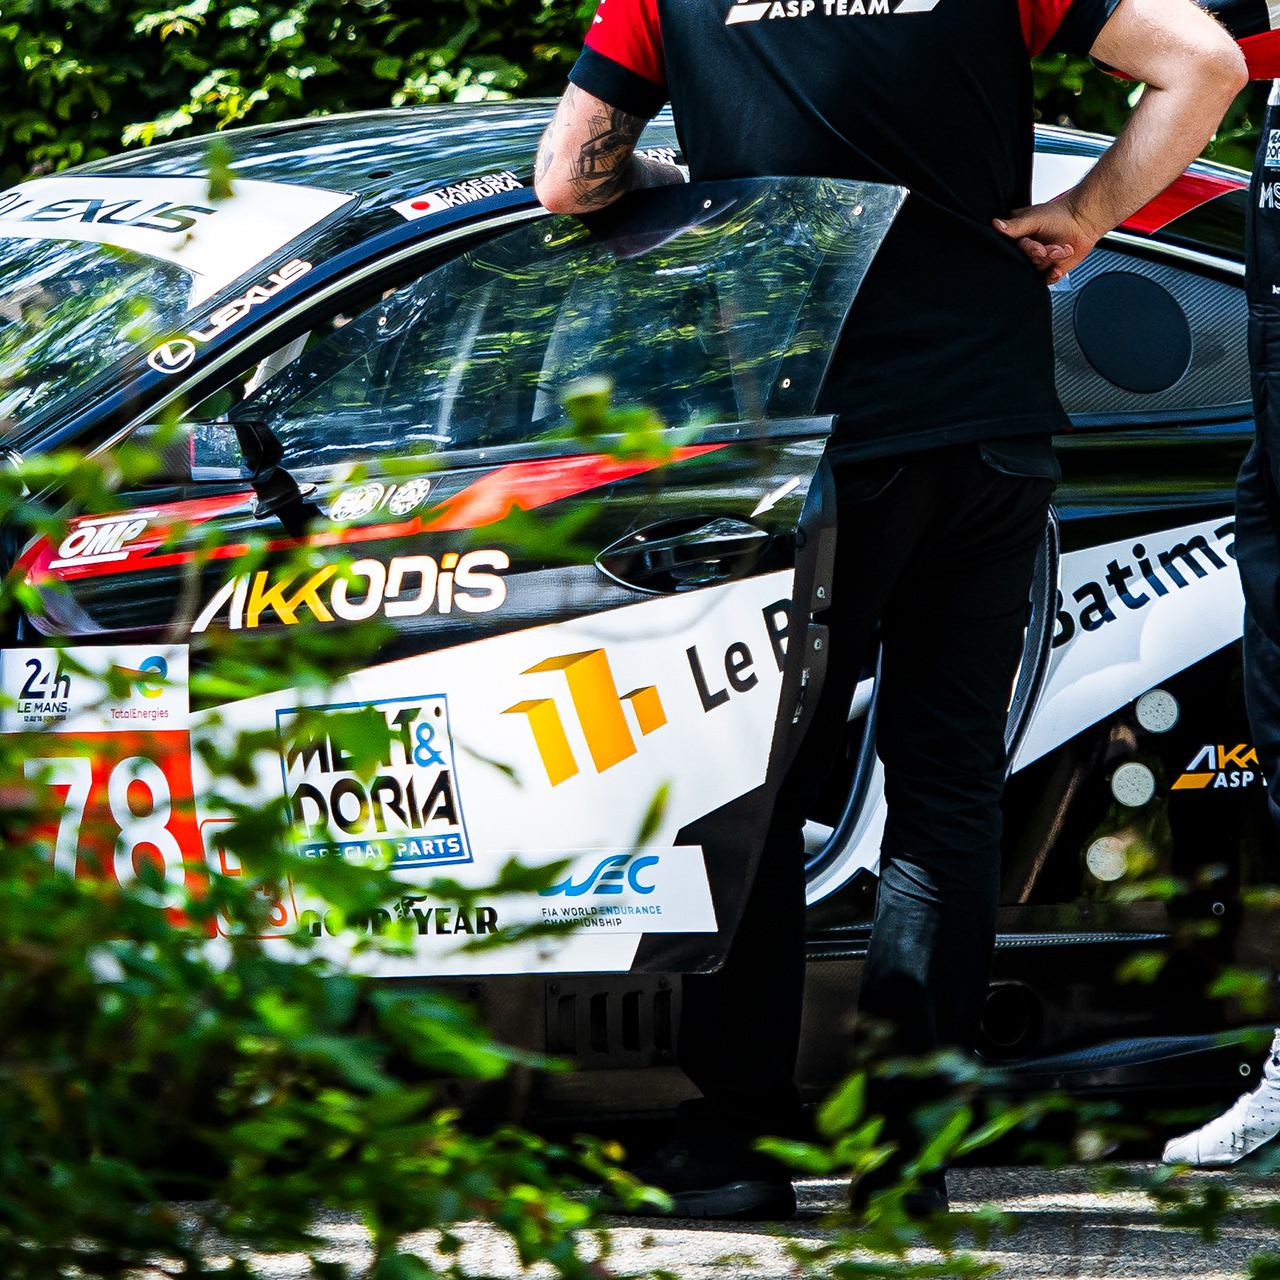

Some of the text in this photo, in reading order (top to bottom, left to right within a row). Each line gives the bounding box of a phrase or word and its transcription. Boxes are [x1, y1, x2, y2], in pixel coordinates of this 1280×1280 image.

[768, 0, 814, 20] ASP
[433, 170, 518, 200] TAKESHI
[444, 179, 525, 208] KIMURA
[188, 257, 314, 343] LEXUS
[58, 519, 149, 560] OMP
[18, 657, 71, 700] 24h
[685, 640, 760, 714] Le
[17, 701, 69, 714] LE MANS
[110, 707, 170, 722] TotalEnergies
[1213, 770, 1255, 789] ASP
[290, 769, 459, 838] DORIA
[22, 756, 187, 910] 78
[396, 836, 461, 859] PARTS
[537, 853, 660, 897] WEC
[541, 904, 663, 918] FIA WORLD ENDURANCE
